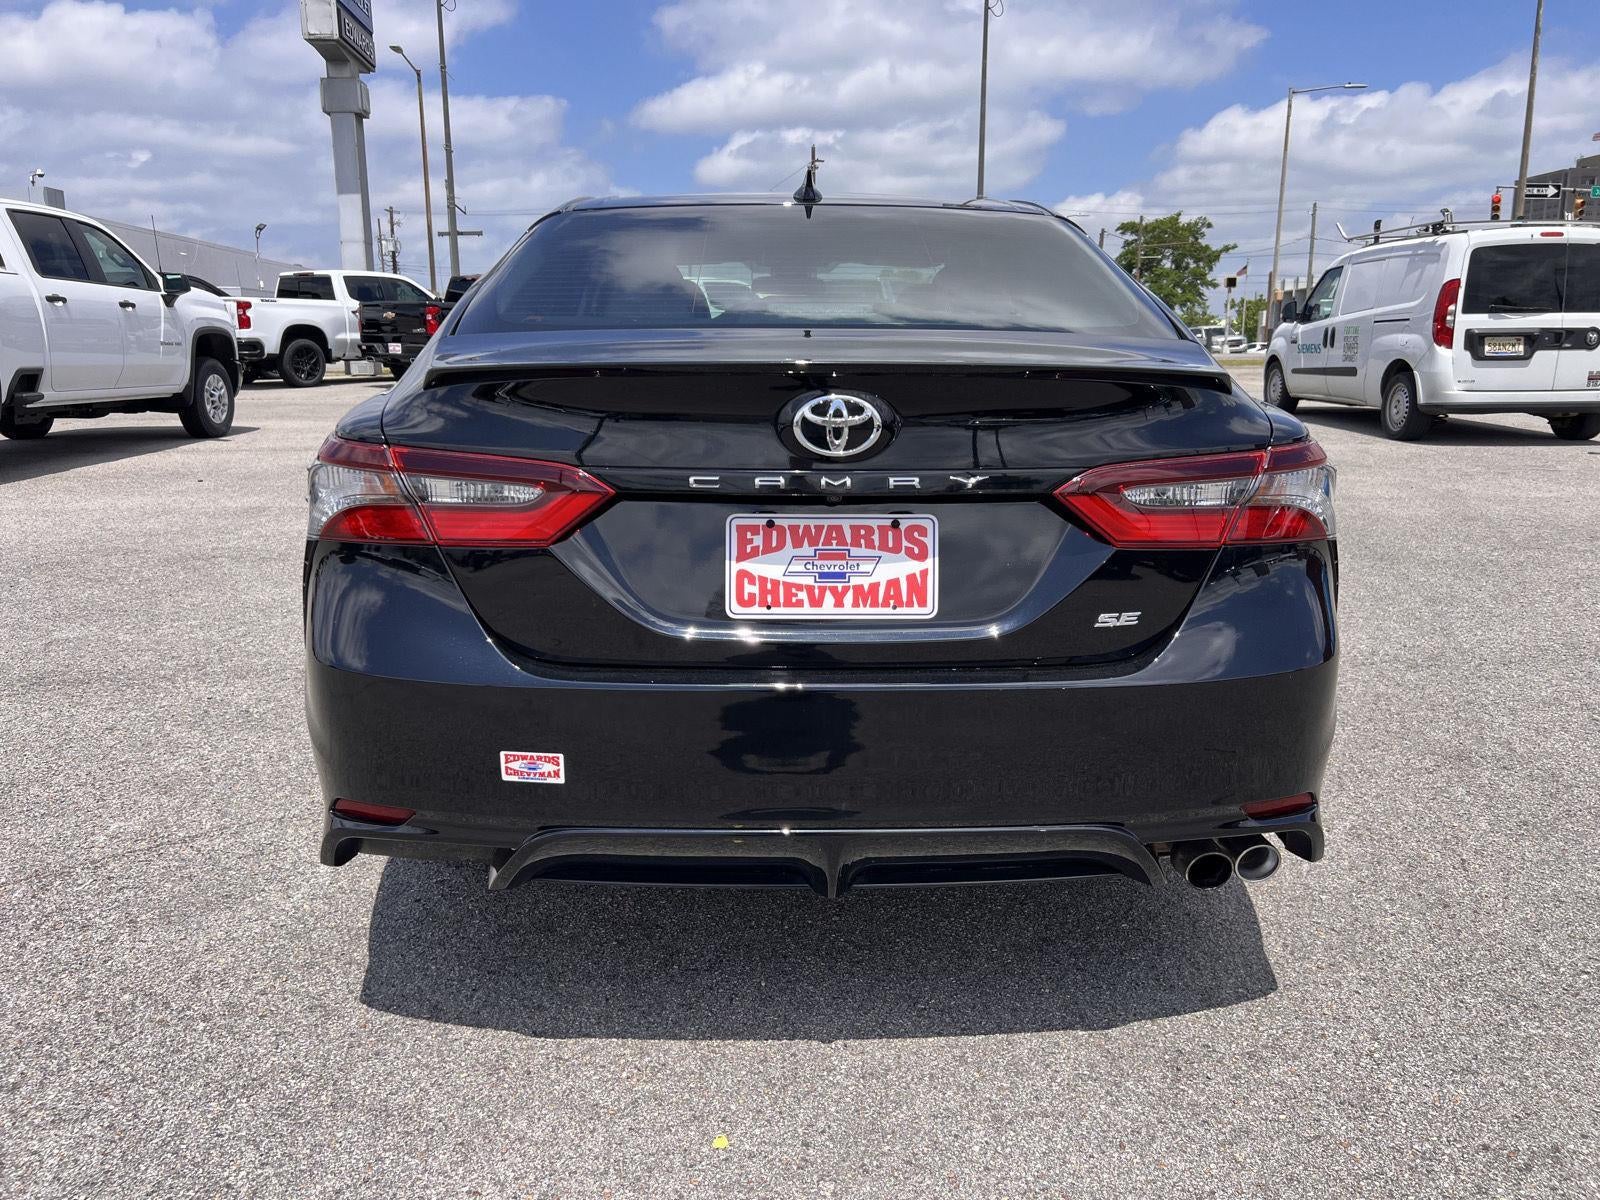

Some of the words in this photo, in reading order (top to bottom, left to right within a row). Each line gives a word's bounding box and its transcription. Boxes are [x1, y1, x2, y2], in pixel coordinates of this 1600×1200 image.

[344, 17, 374, 60] EDWARDS
[1297, 343, 1321, 354] SIEMENS
[689, 475, 989, 489] CAMRY
[735, 524, 929, 564] EDWARDS
[803, 561, 861, 571] Chevrolet
[735, 567, 929, 608] CHEVYMAN
[1094, 611, 1142, 628] SE
[504, 753, 560, 767] EDWARDS
[504, 765, 561, 779] CHEVYMAN
